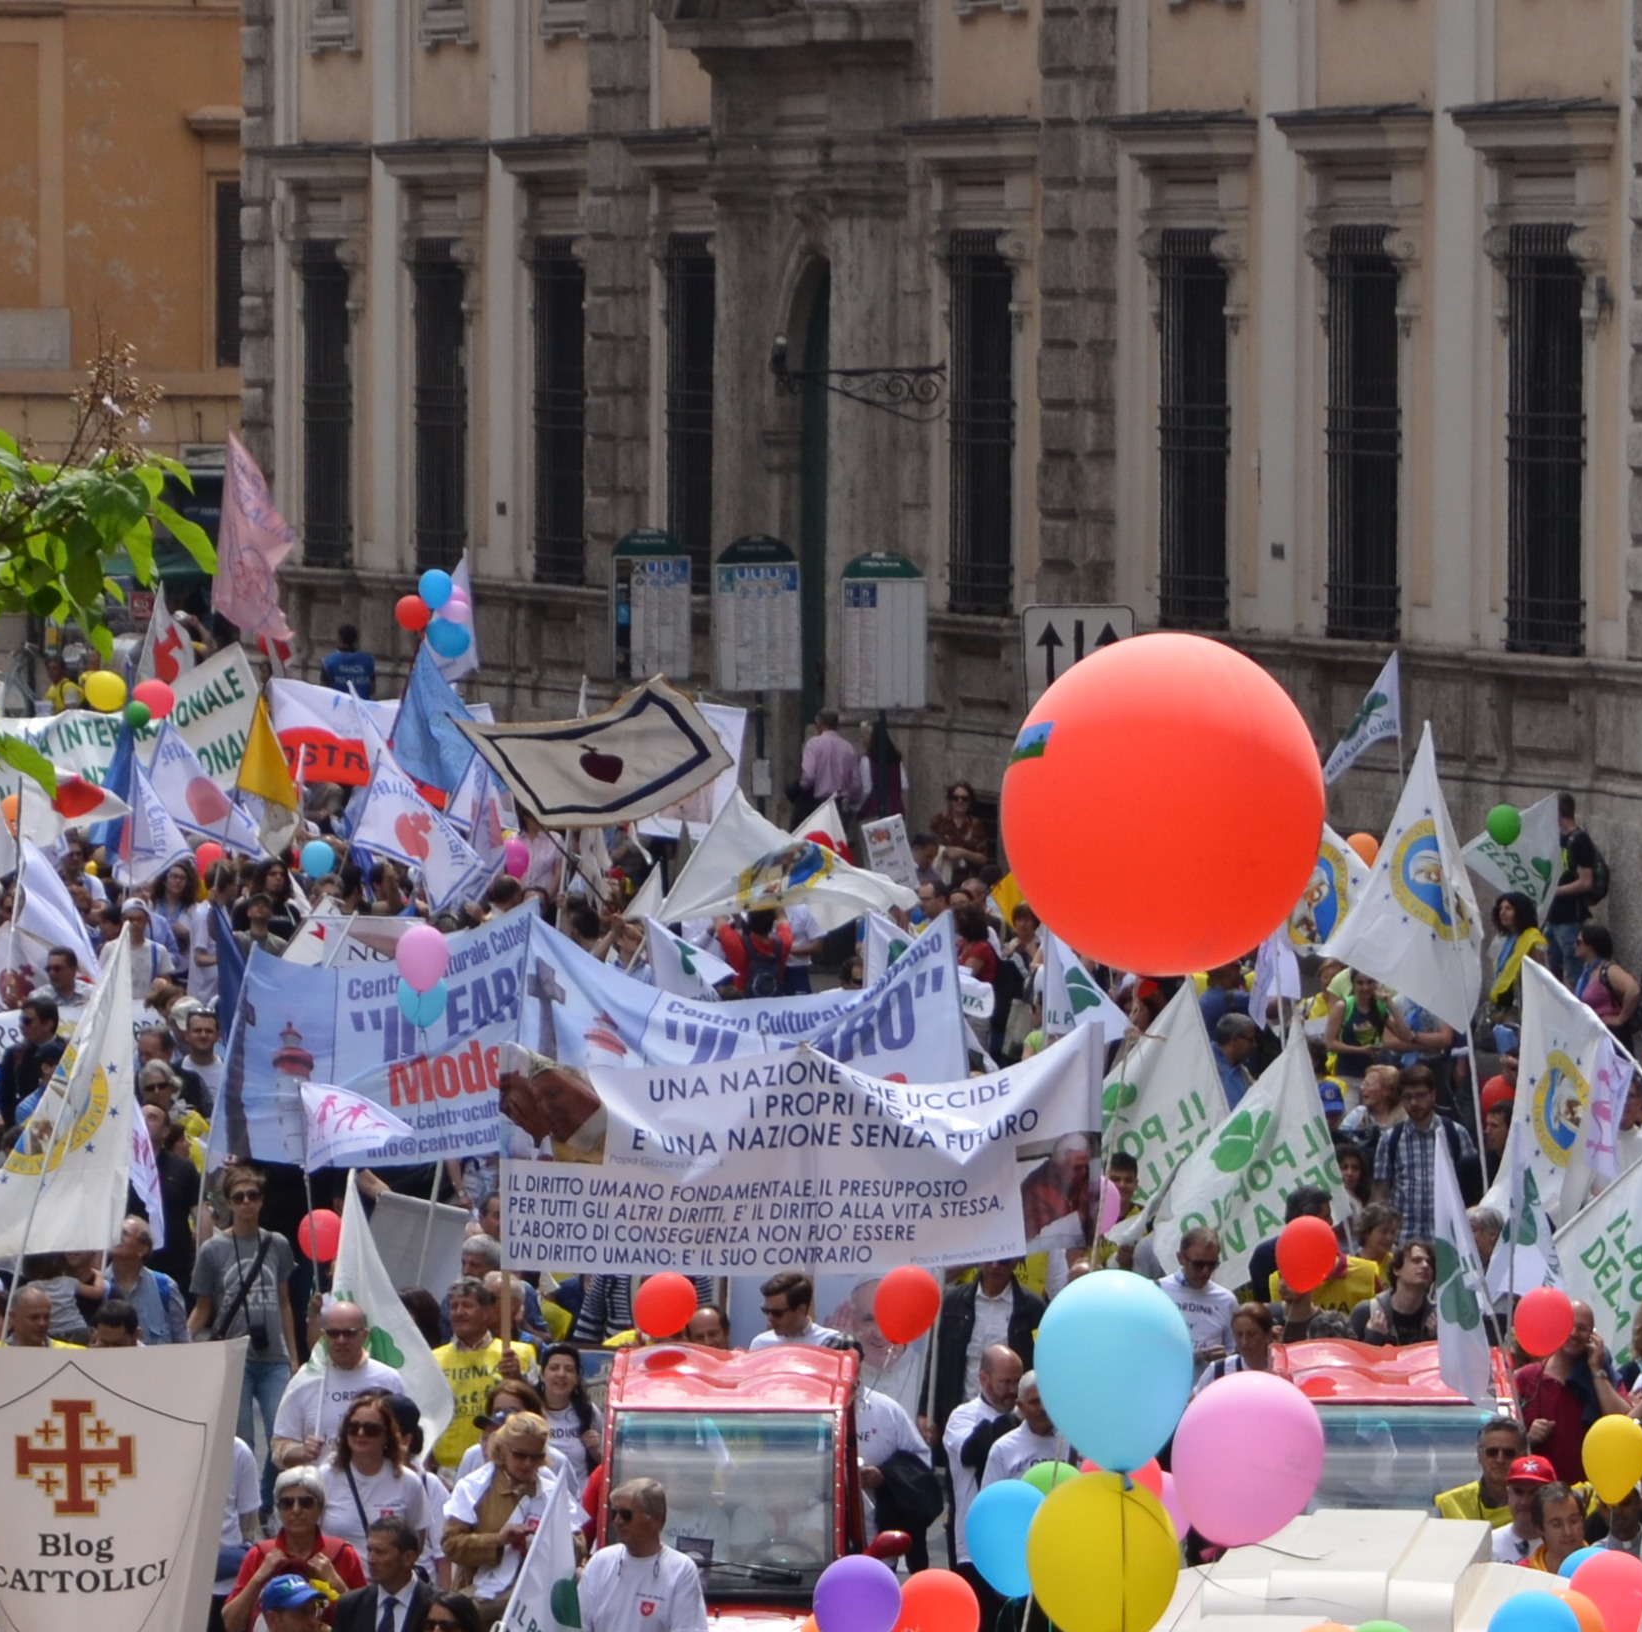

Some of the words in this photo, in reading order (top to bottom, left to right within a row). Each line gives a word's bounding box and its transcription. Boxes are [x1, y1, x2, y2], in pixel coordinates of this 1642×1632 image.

[649, 1074, 714, 1103] UNA
[720, 1060, 841, 1096] NAZIONE
[850, 1074, 898, 1102] CHE
[907, 1077, 1012, 1112] UCCIDE
[749, 1099, 756, 1119] I
[764, 1091, 855, 1119] PROPRI
[632, 1129, 653, 1151] E'
[660, 1129, 717, 1157] UNA
[727, 1122, 841, 1150] NAZIONE
[849, 1121, 937, 1149] SENZA
[945, 1108, 1040, 1154] FUTURO
[508, 1175, 520, 1191] IL
[524, 1176, 585, 1196] DIRITTO
[589, 1179, 664, 1200] UMANO
[670, 1180, 816, 1202] FONDAMENTALE,
[819, 1179, 834, 1197] IL
[838, 1178, 969, 1198] PRESUPPOSTO
[508, 1197, 537, 1214] PER
[540, 1199, 579, 1217] TUTTI
[582, 1201, 611, 1218] GLI
[614, 1202, 664, 1221] ALTRI
[668, 1204, 727, 1224] DIRITTI,
[733, 1203, 750, 1222] E'
[751, 1203, 764, 1221] IL
[768, 1202, 834, 1221] DIRITTO
[839, 1201, 886, 1219] ALLA
[891, 1200, 934, 1220] VITA
[937, 1194, 1006, 1219] STESSA,
[509, 1218, 588, 1241] L'ABORTO
[592, 1223, 611, 1241] DI
[615, 1223, 751, 1245] CONSEGUENZA
[757, 1224, 802, 1244] NON
[807, 1223, 849, 1243] PUO'
[853, 1223, 917, 1242] ESSERE
[509, 1242, 533, 1260] UN
[536, 1243, 599, 1264] DIRITTO
[603, 1245, 679, 1267] UMANO:
[682, 1245, 699, 1266] E'
[701, 1247, 715, 1266] IL
[719, 1246, 758, 1266] SUO
[763, 1244, 873, 1265] CONTRARIO
[38, 1532, 115, 1563] Blog
